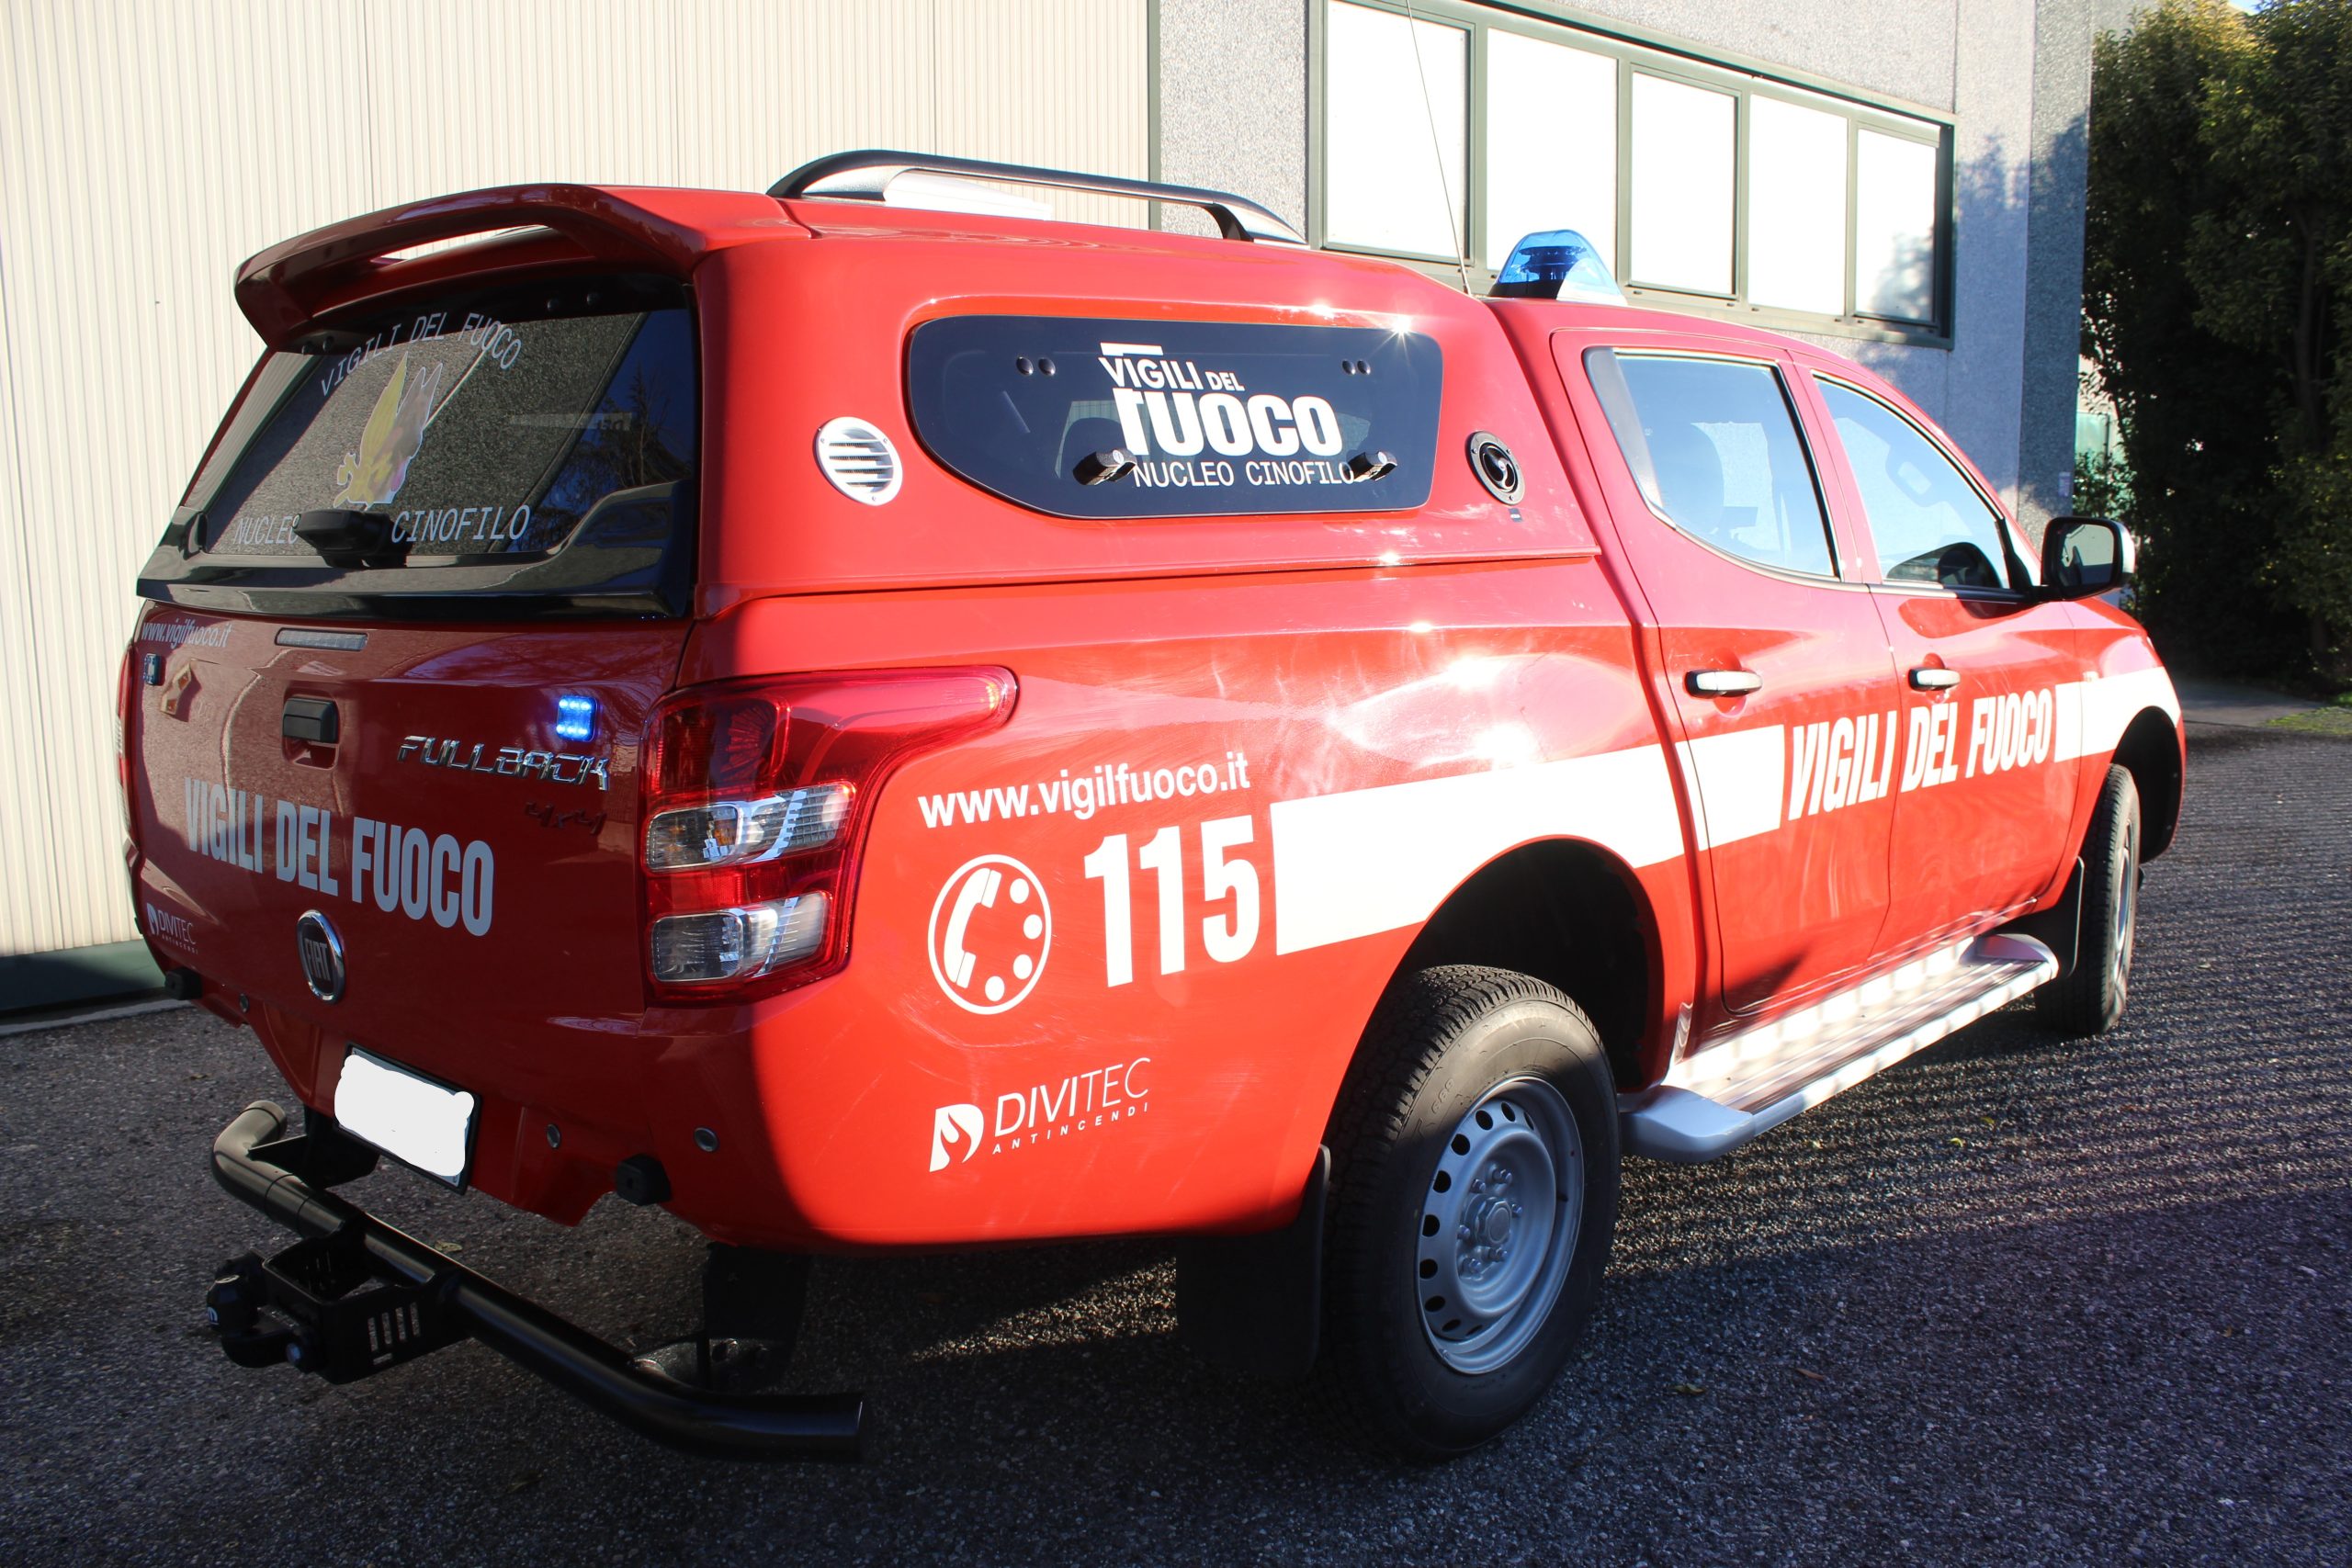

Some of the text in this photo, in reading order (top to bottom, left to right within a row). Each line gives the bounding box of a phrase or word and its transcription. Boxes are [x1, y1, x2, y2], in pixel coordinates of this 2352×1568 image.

[321, 311, 522, 397] VIGILI DEL FUOCO
[1098, 356, 1246, 392] VIGILI DEL
[1113, 387, 1343, 457] FUOCO
[1132, 460, 1355, 488] NUCLEO CINOFILO
[391, 504, 531, 544] CINOFILO
[141, 617, 233, 649] www.vigilfuoco.it
[396, 735, 610, 791] FULLBACK
[1787, 688, 2053, 821] VIGILI DEL FUOCO
[918, 750, 1251, 829] www.vigilfuoco.it
[184, 777, 495, 938] VIGILI DEL FUOCO
[157, 909, 196, 945] DIVITEC
[1083, 814, 1261, 988] 115
[304, 938, 331, 981] FIAT
[993, 1056, 1151, 1138] DIVITEC
[991, 1101, 1150, 1156] ANTINCENDI
